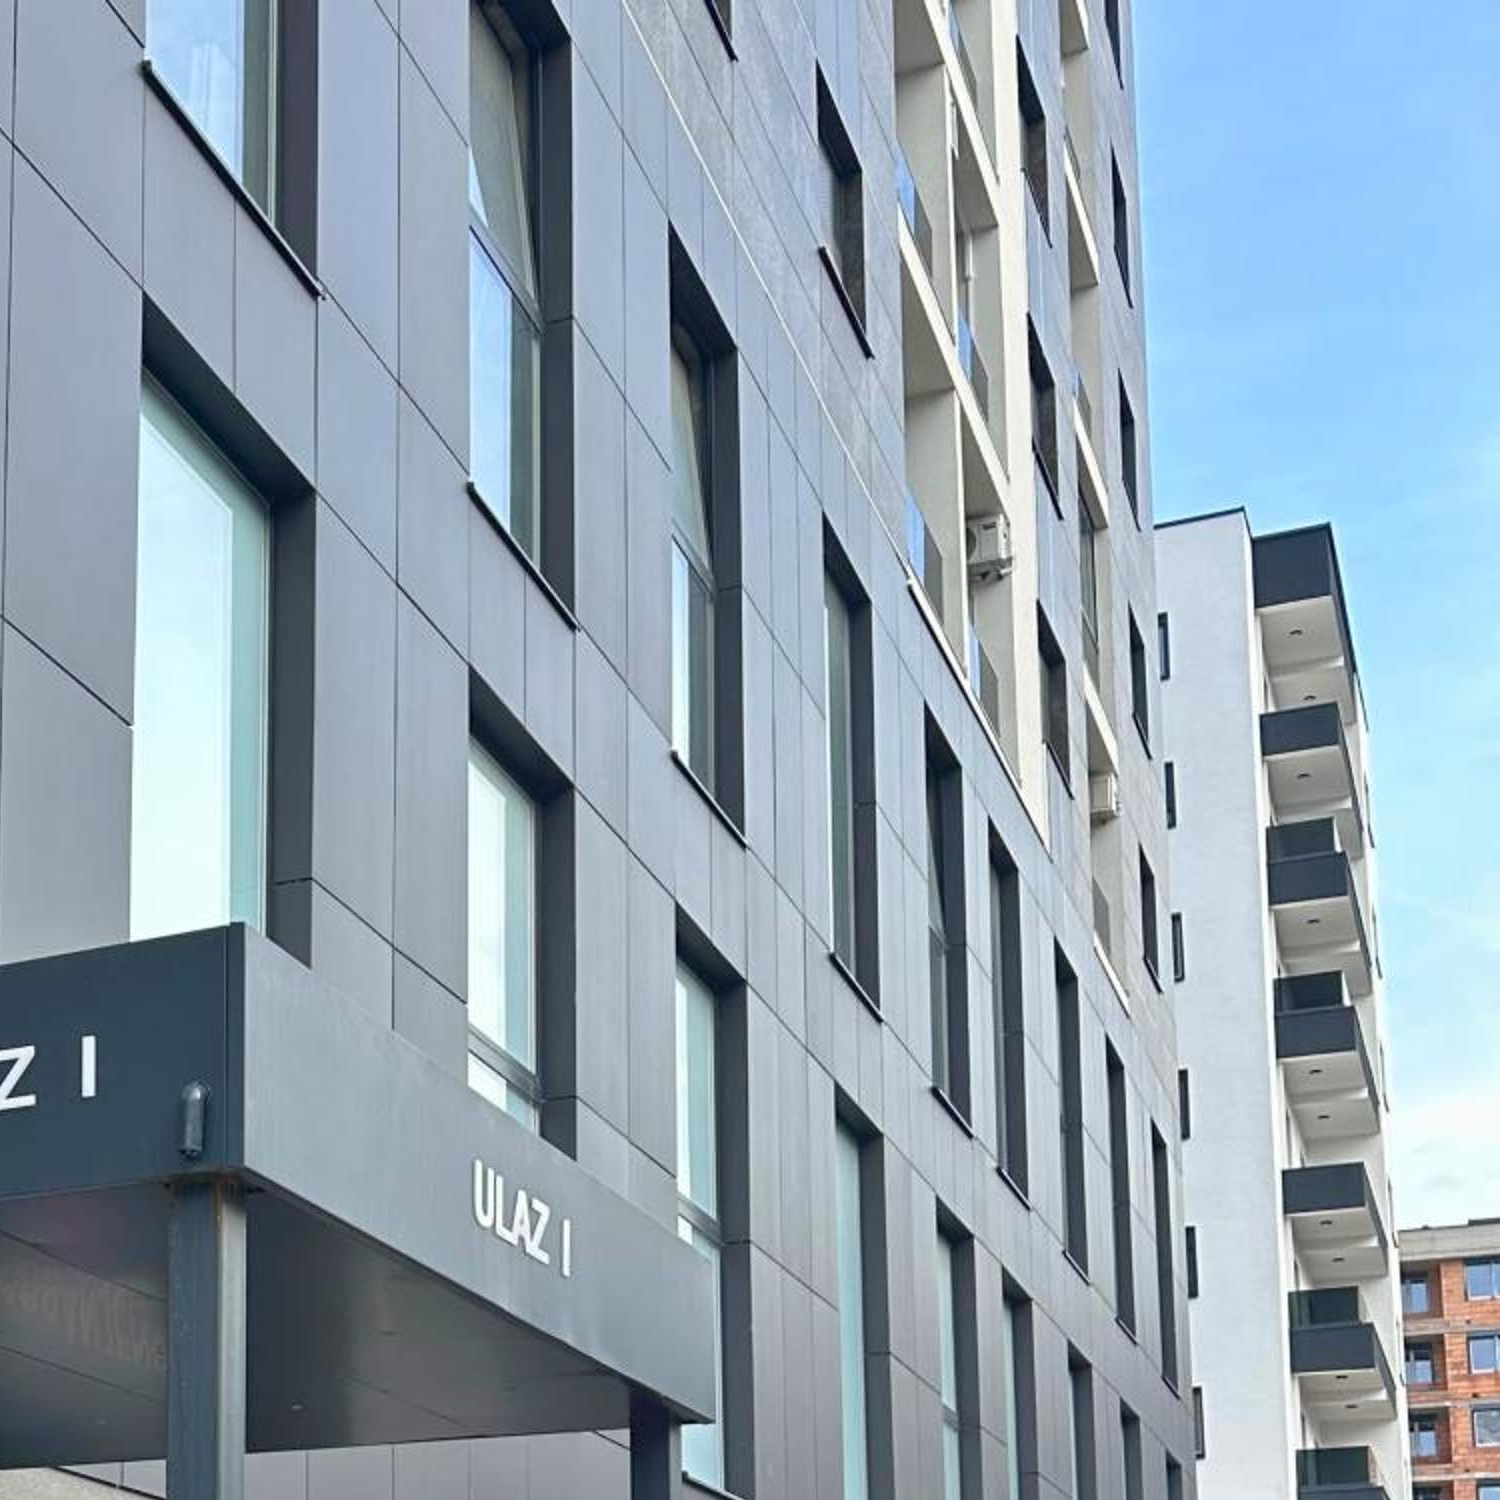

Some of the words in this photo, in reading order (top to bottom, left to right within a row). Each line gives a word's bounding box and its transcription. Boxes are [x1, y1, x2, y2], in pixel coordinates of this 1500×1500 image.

[81, 1035, 97, 1098] I
[474, 1158, 550, 1265] ULAZ
[562, 1219, 571, 1277] I
